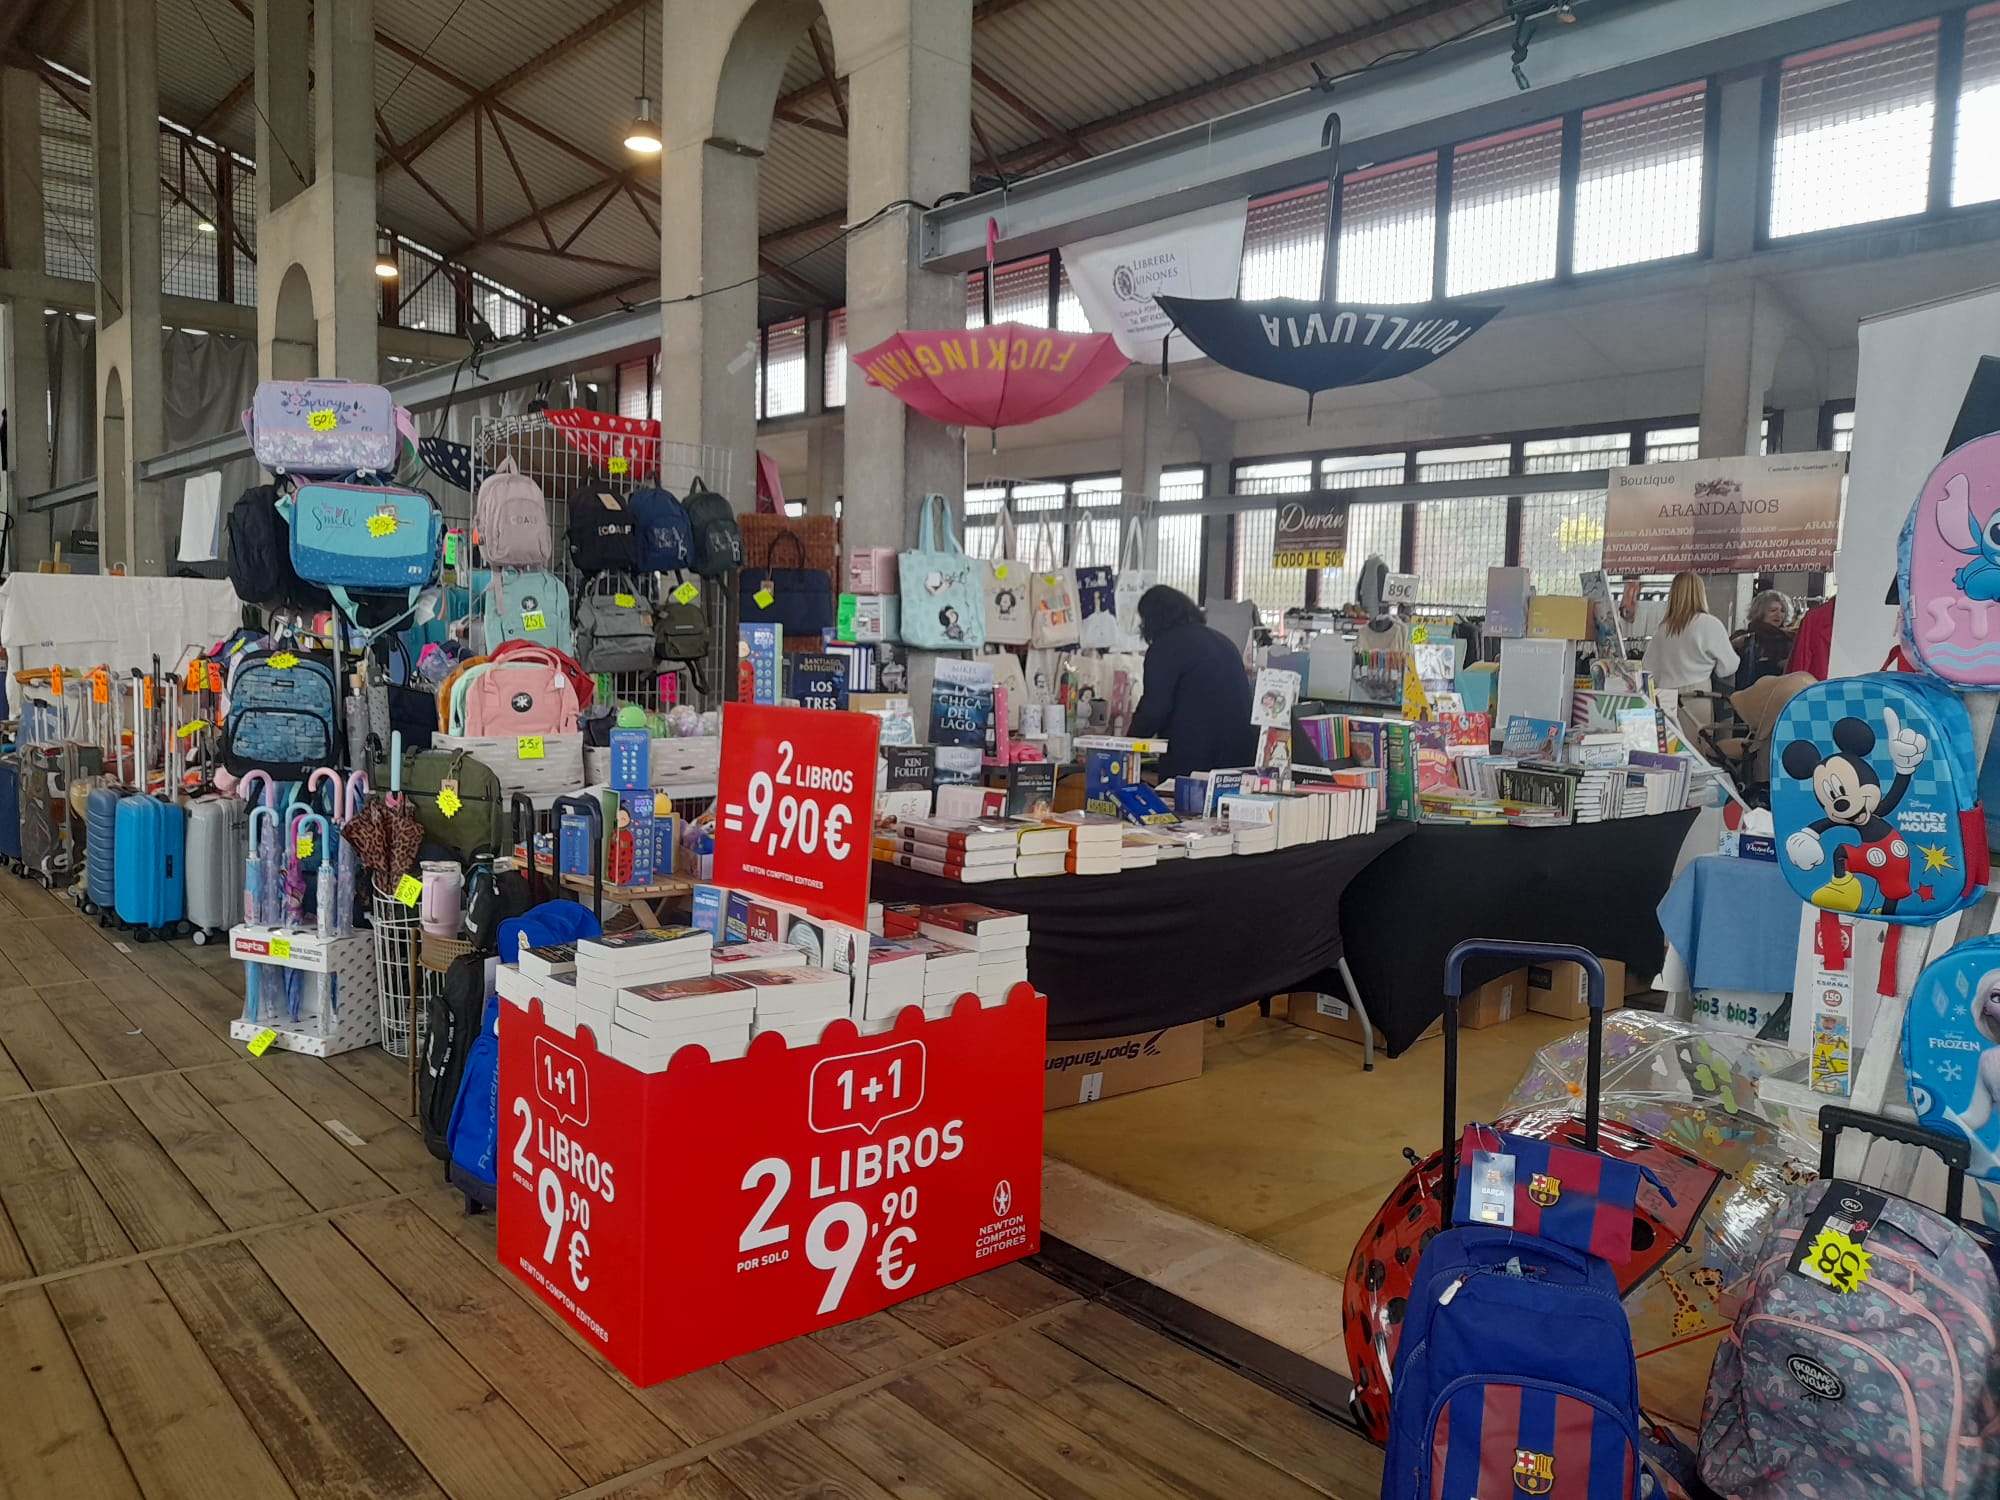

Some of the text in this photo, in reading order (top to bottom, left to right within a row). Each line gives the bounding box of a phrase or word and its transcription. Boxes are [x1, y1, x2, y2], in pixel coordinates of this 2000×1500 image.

[1259, 312, 1472, 355] PUTA LLUVIA
[866, 337, 1077, 391] FUCKING RAIN
[1620, 475, 1675, 487] Boutique
[1658, 499, 1780, 518] ARANDANOS
[1279, 502, 1344, 532] Durán
[1725, 539, 1788, 549] ARANDANOS
[1274, 553, 1304, 567] TODO
[1307, 553, 1320, 566] AL
[1753, 548, 1817, 559] ARANDANOS
[523, 614, 544, 628] 25%
[810, 681, 833, 692] LOS
[955, 685, 969, 697] LA
[804, 697, 837, 710] TRES
[939, 695, 982, 709] CHICA
[947, 707, 971, 720] DEL
[940, 718, 976, 731] LAGO
[775, 740, 854, 793] 2 LIBROS
[904, 758, 922, 767] KEN
[894, 766, 930, 778] FOLLETT
[1897, 811, 1947, 823] MICKEY
[1900, 821, 1947, 833] MOUSE
[743, 863, 824, 890] NEWTON COMPTON EDITORES
[757, 916, 767, 928] LA
[1825, 992, 1841, 1001] 150
[1727, 1000, 1757, 1026] bio3
[1928, 1037, 1981, 1052] FROZEN
[544, 1054, 576, 1105] 1+1
[837, 1058, 902, 1111] 1+1
[512, 1096, 615, 1203] 2 LIBROS
[739, 1119, 965, 1252] 2 LIBROS
[978, 1214, 1024, 1236] NEWTON
[975, 1223, 1026, 1248] COMPTON
[975, 1233, 1026, 1259] EDITORES
[737, 1250, 789, 1273] POR SOLO
[519, 1256, 609, 1343] NEWTON COMPTON EDITORES
